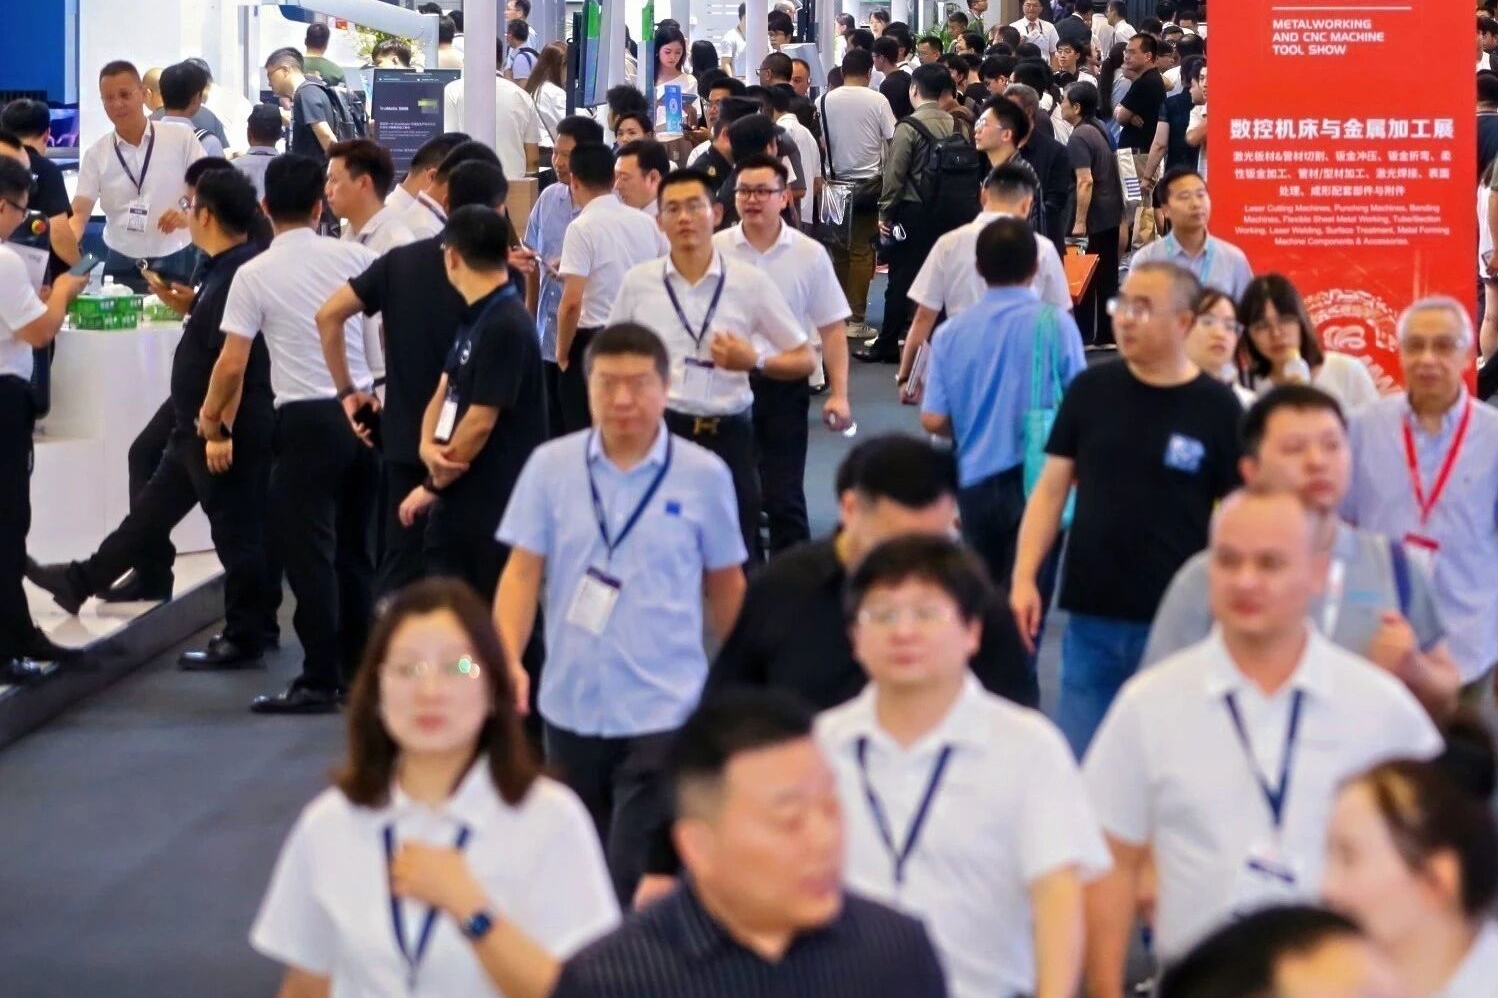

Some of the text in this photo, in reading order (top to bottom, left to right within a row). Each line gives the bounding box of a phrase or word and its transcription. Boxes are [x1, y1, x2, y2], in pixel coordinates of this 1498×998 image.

[1273, 19, 1372, 30] METALWORKING
[1273, 32, 1384, 43] AND CNC MACHINE
[1273, 45, 1346, 56] TOOL SHOW
[1230, 118, 1455, 140] 数控机床与金属加工展
